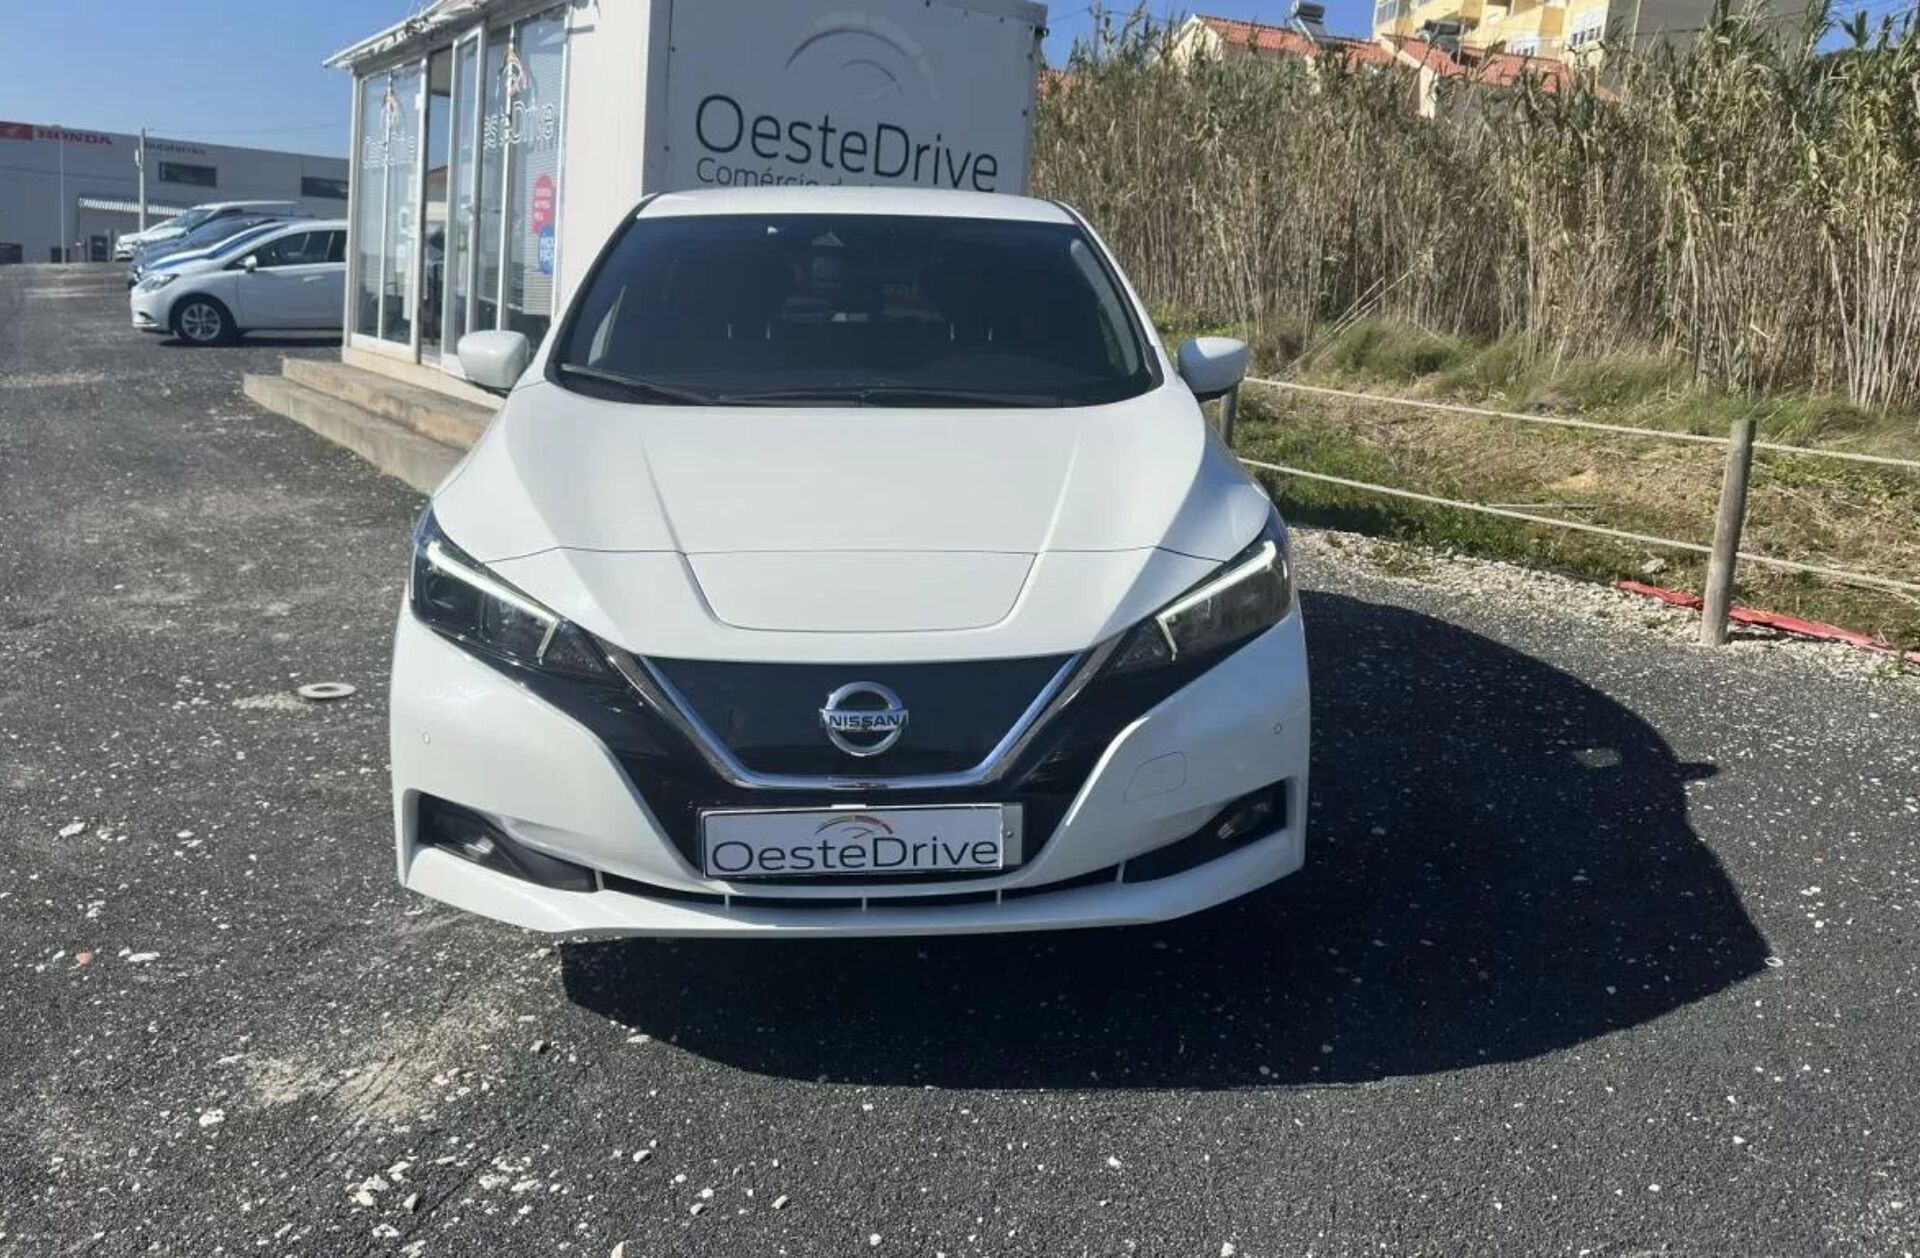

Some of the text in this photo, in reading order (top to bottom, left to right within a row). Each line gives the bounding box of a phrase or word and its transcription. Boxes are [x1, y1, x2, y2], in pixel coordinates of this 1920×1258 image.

[38, 127, 112, 145] HONDA
[695, 94, 999, 194] OesteDrive
[828, 713, 899, 728] NISSAN
[712, 836, 999, 873] OesteDrive
